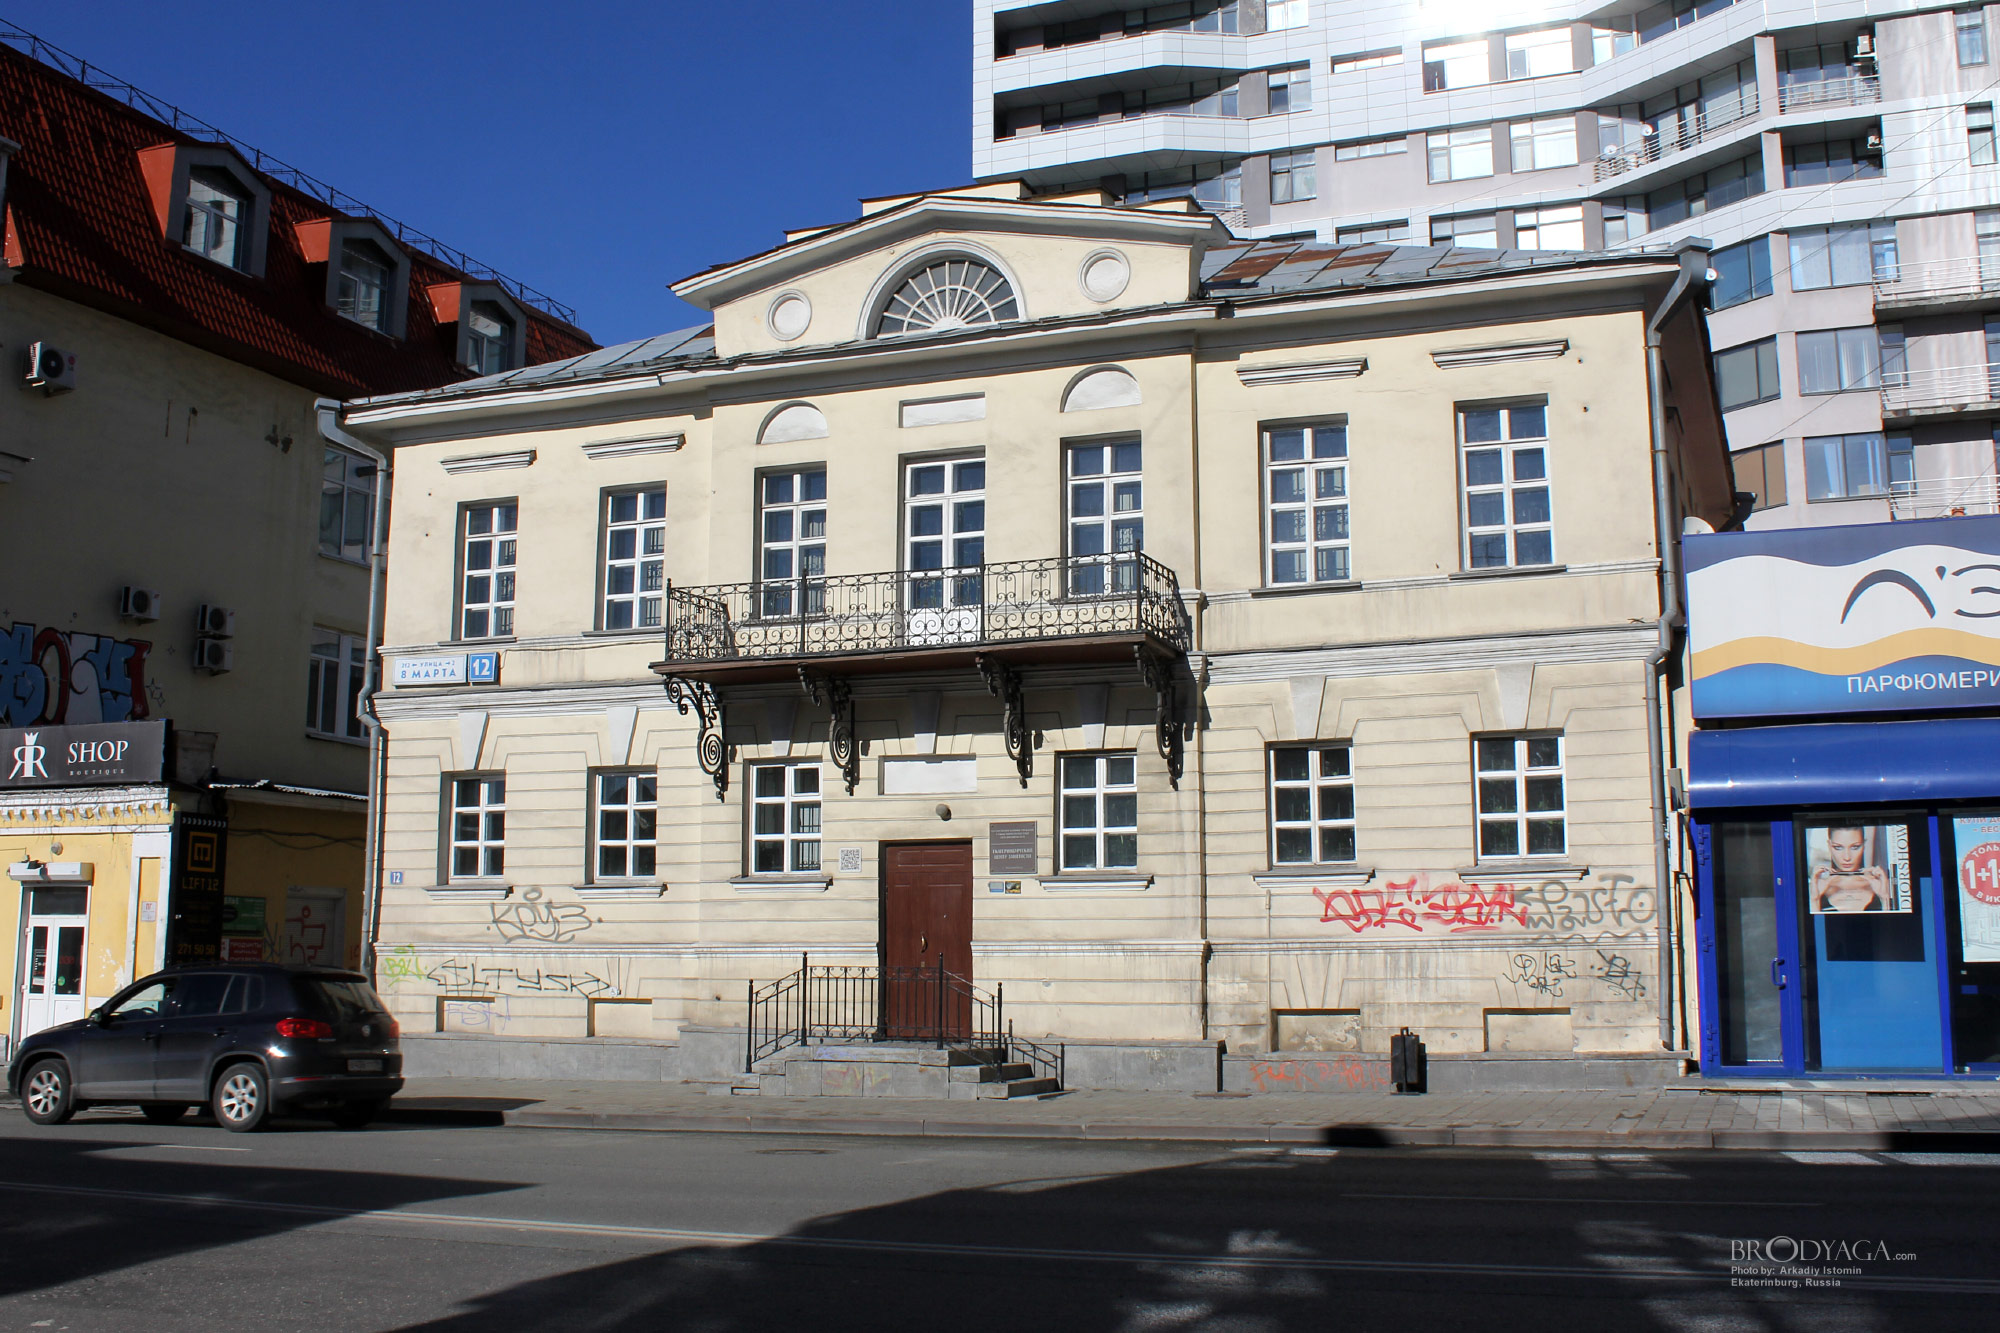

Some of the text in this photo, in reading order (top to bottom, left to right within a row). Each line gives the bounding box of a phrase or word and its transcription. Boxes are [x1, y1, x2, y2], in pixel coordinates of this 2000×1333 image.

[400, 668, 457, 679] 8 МАРТА
[472, 658, 491, 676] 12
[67, 740, 129, 765] SHOP
[69, 768, 126, 776] BOUTIQUE
[1896, 825, 1912, 910] DIORSHOW
[392, 872, 401, 883] 12
